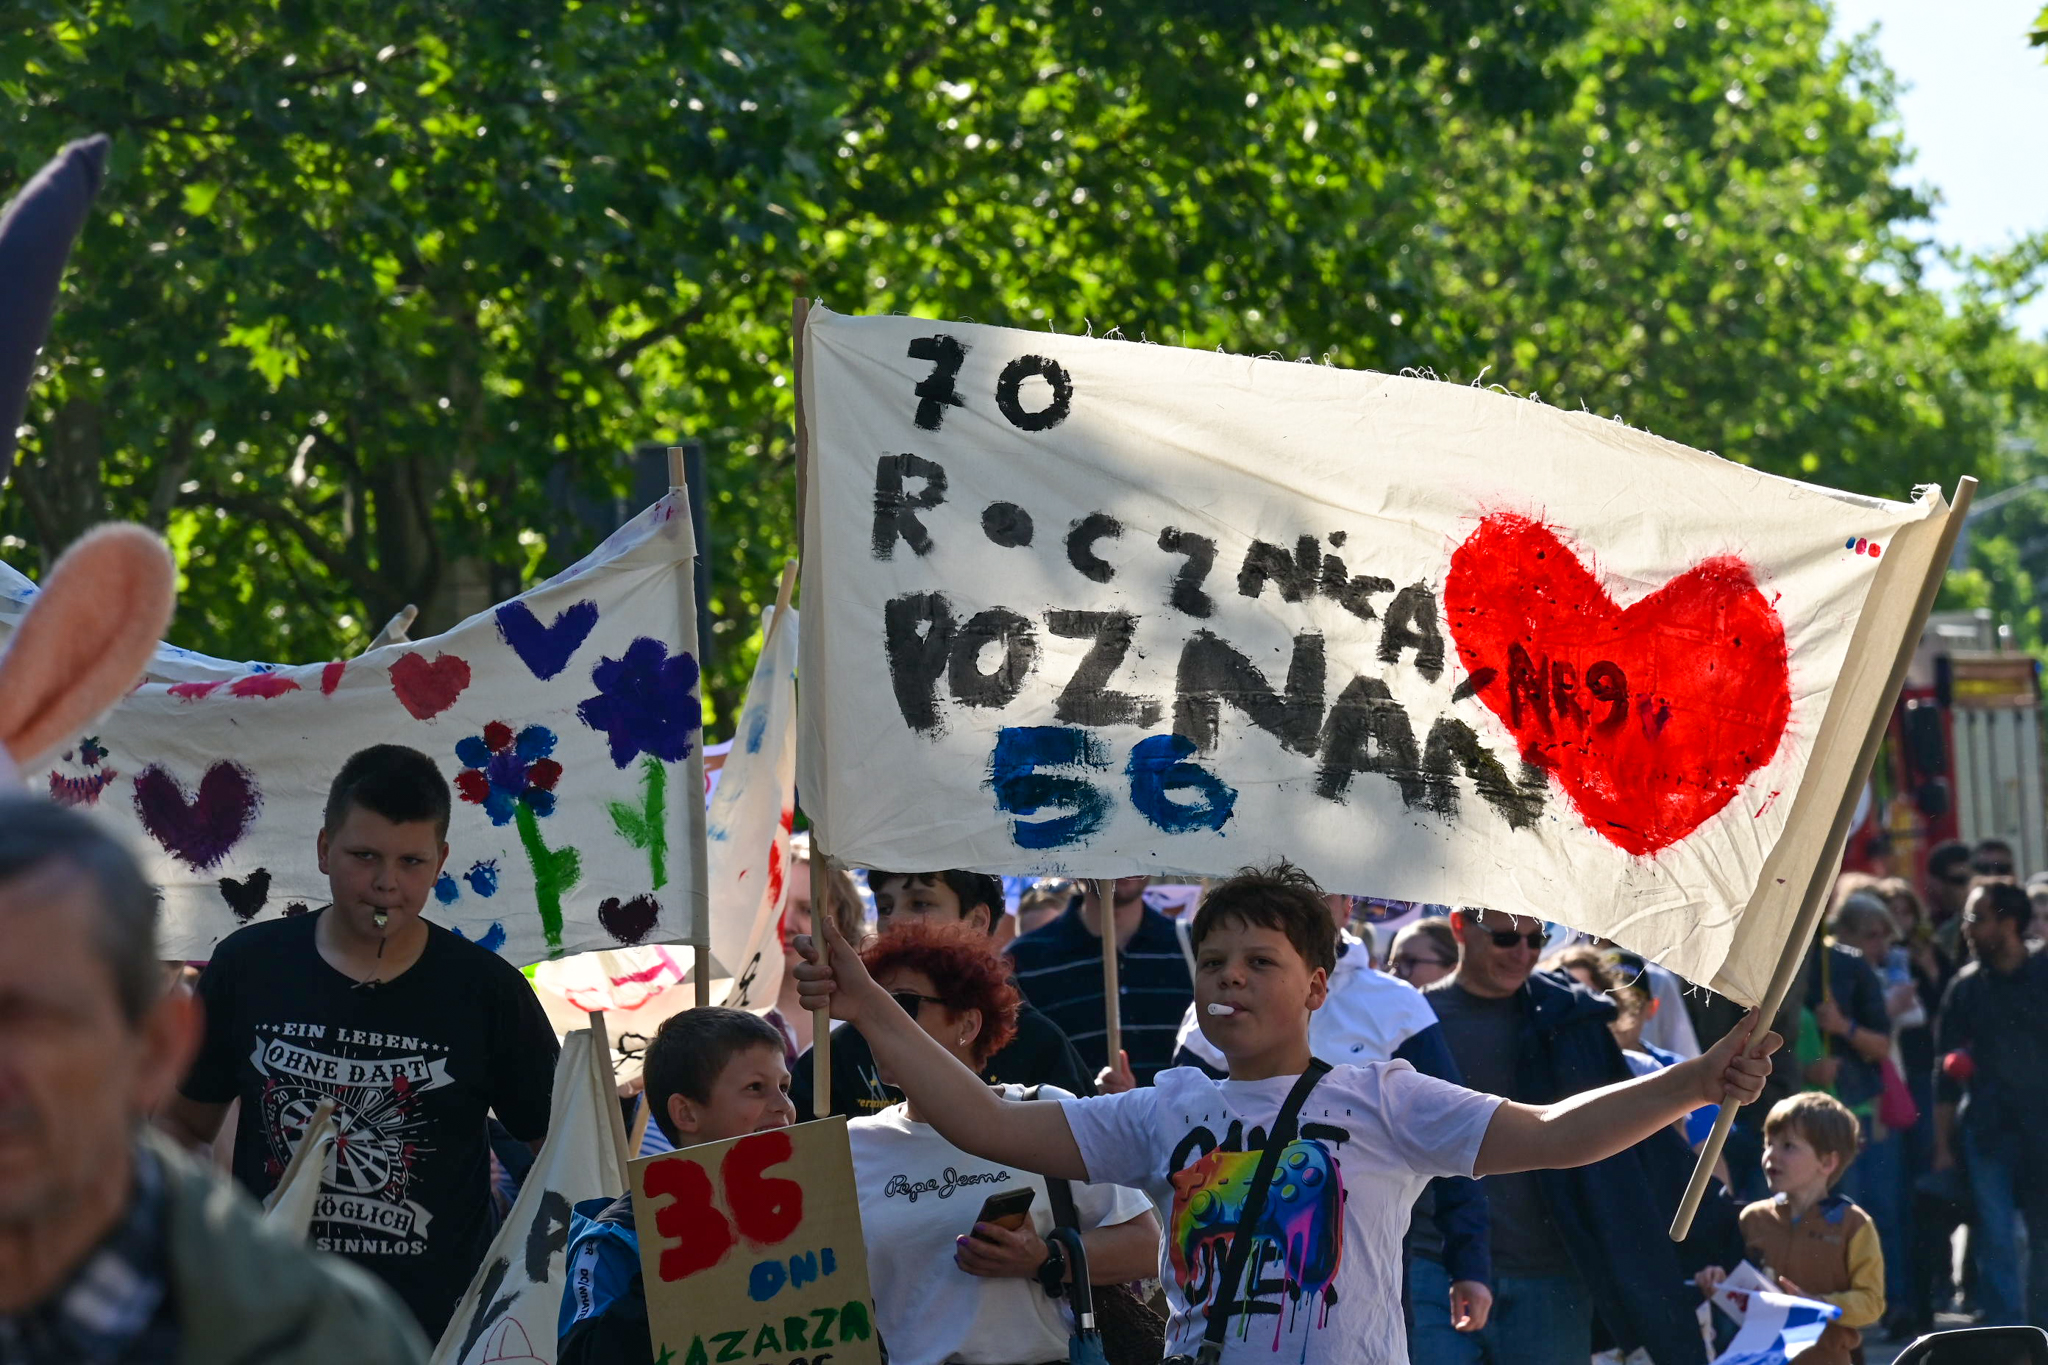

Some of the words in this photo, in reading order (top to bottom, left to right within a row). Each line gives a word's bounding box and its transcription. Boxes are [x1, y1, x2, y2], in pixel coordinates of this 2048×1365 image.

[907, 332, 1074, 432] 70
[982, 725, 1238, 850] 56
[281, 1021, 327, 1039] EIN
[336, 1027, 420, 1051] LEBEN
[268, 1045, 339, 1079] OHNE
[349, 1060, 426, 1084] DART
[884, 1174, 940, 1203] Pepe
[938, 1167, 1011, 1199] Jeans
[642, 1130, 803, 1283] 36
[316, 1238, 424, 1255] SINNLOS
